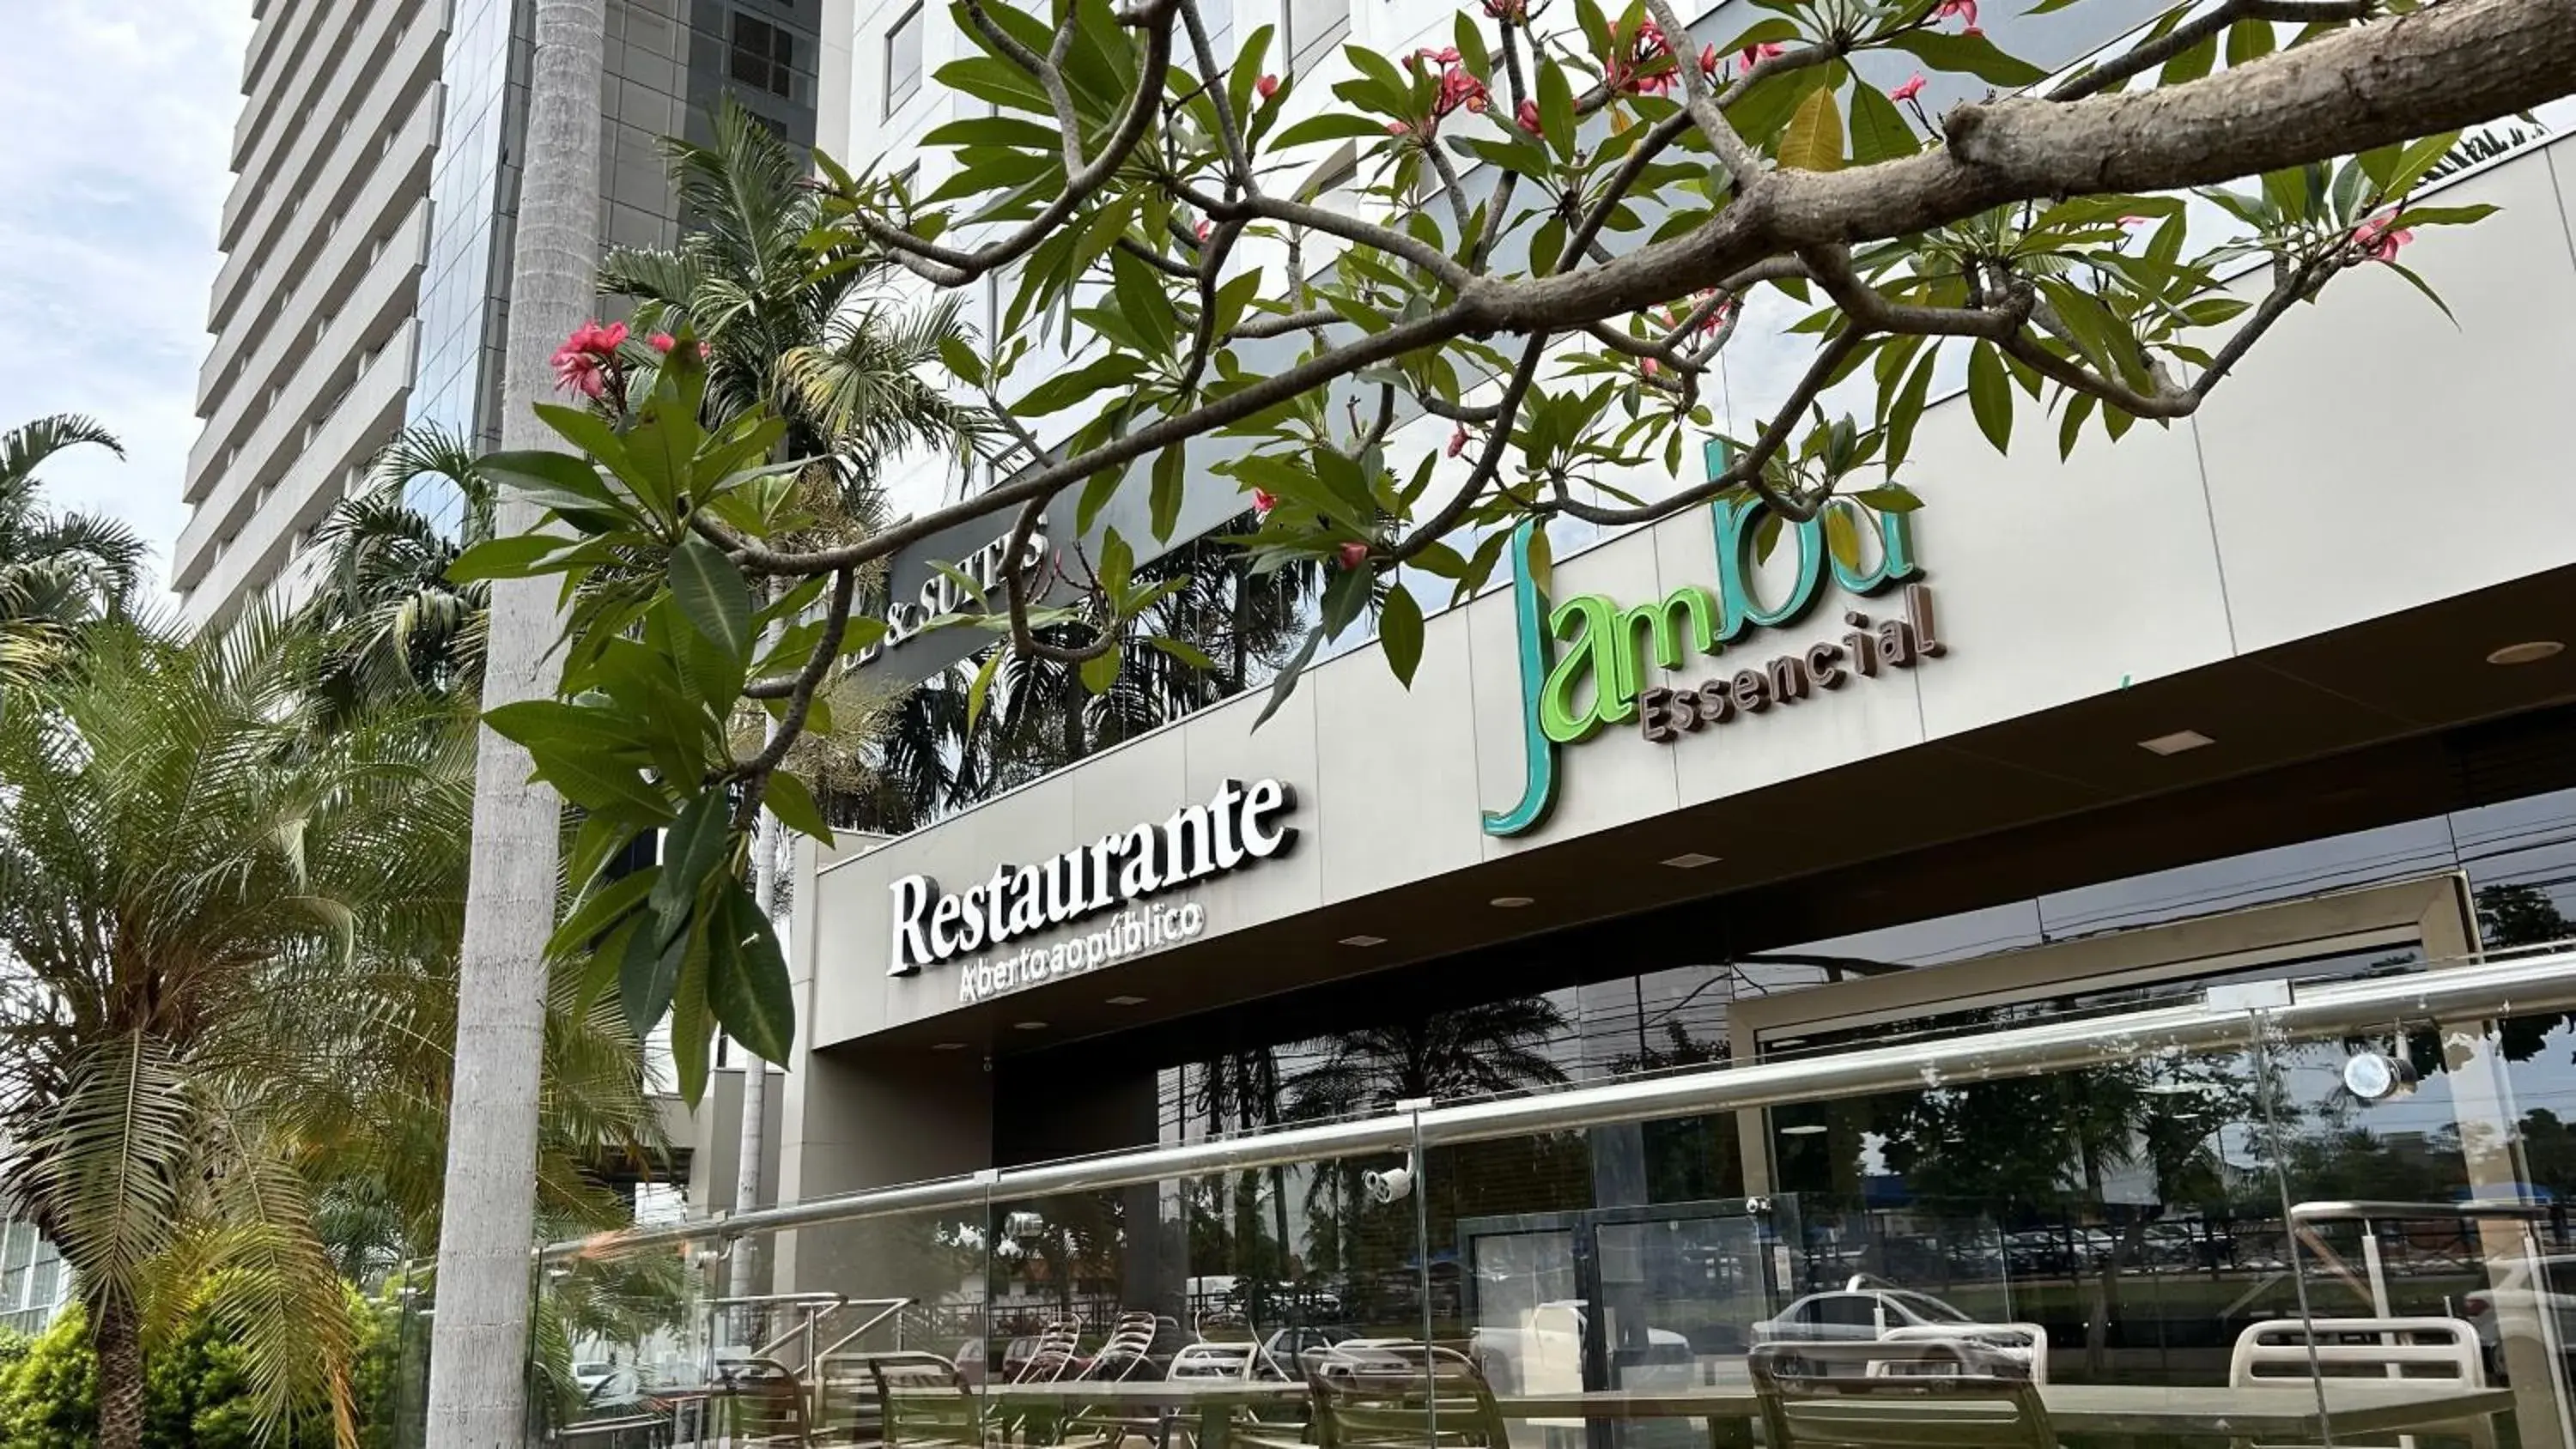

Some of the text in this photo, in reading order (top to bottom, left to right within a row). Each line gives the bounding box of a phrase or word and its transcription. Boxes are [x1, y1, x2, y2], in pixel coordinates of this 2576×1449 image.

[884, 602, 921, 646] &
[1482, 437, 1923, 838] Jambu
[1638, 584, 1946, 744] Essencial
[887, 778, 1297, 977] Restaurante
